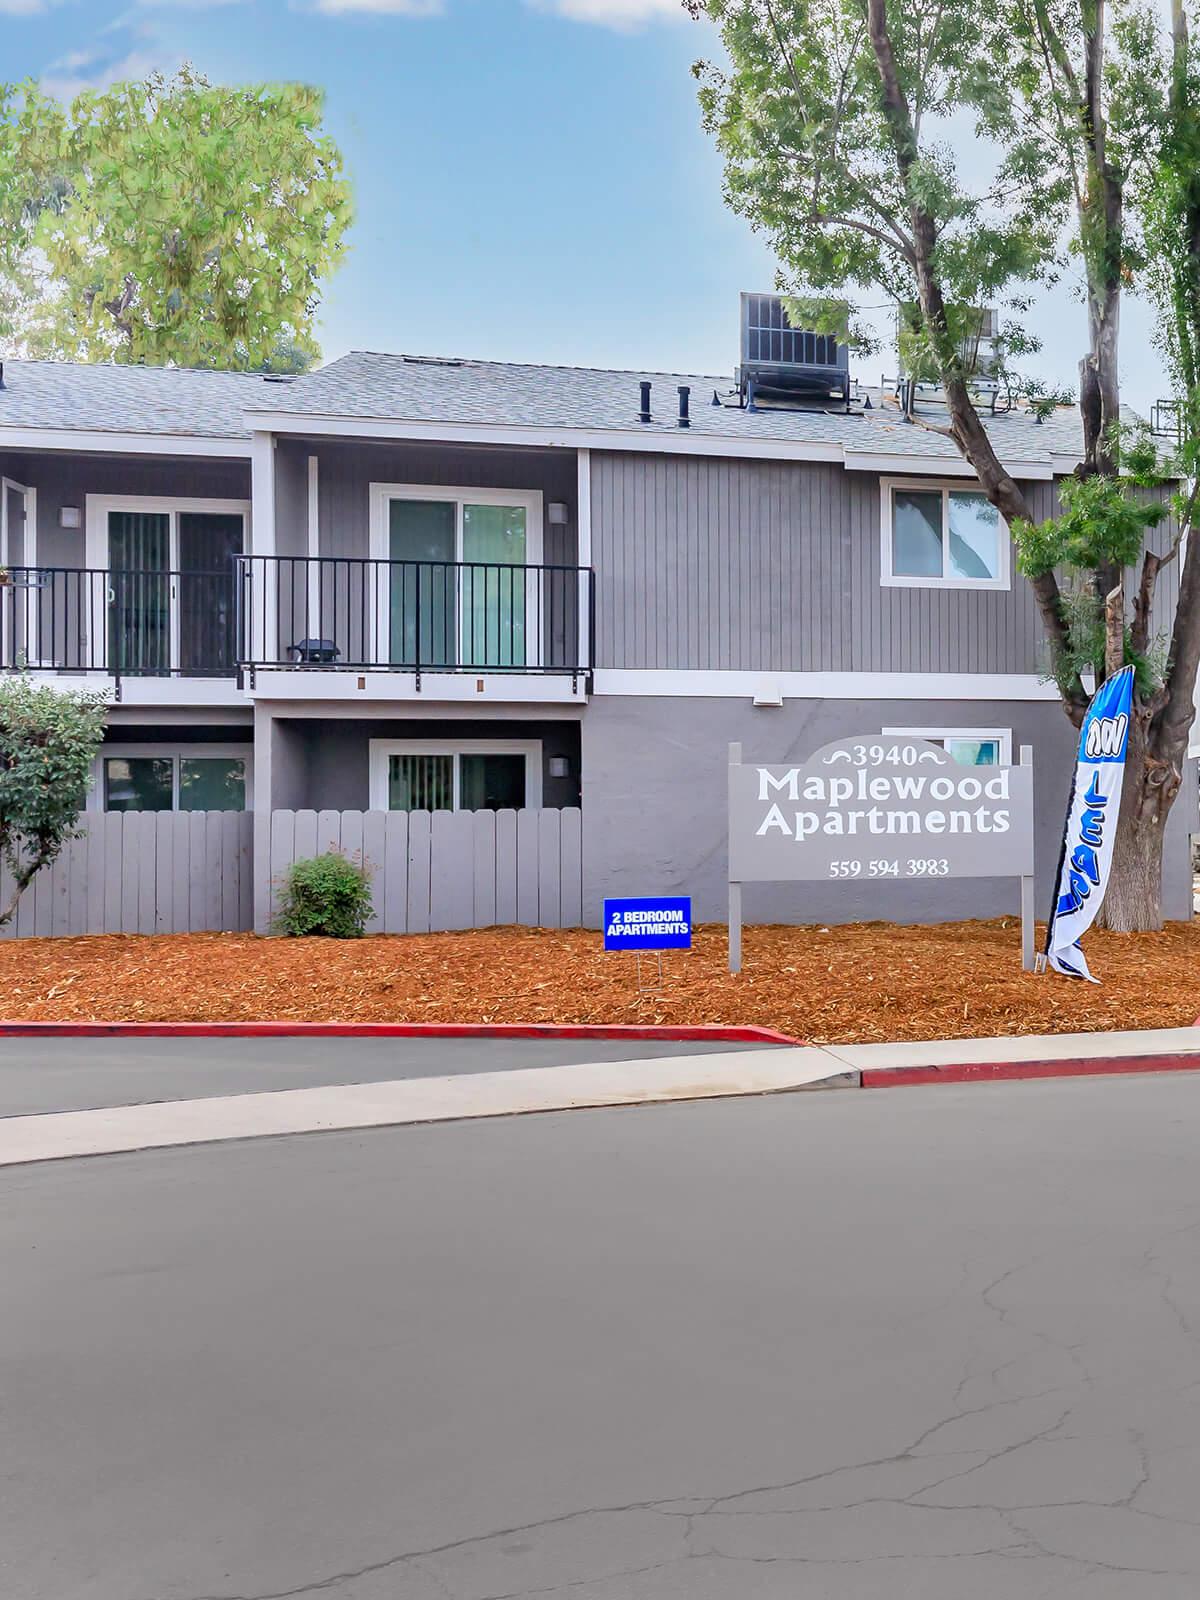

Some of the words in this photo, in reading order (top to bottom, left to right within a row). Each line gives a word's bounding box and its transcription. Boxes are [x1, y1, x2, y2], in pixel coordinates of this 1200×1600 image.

[852, 745, 918, 766] 3940
[756, 768, 1010, 807] Maplewood
[756, 803, 1010, 841] Apartments
[829, 860, 862, 877] 559
[868, 860, 900, 877] 594
[906, 859, 949, 876] 3983
[612, 912, 621, 924] 2
[624, 910, 683, 923] BEDROOM
[607, 922, 688, 936] APARTMENTS
